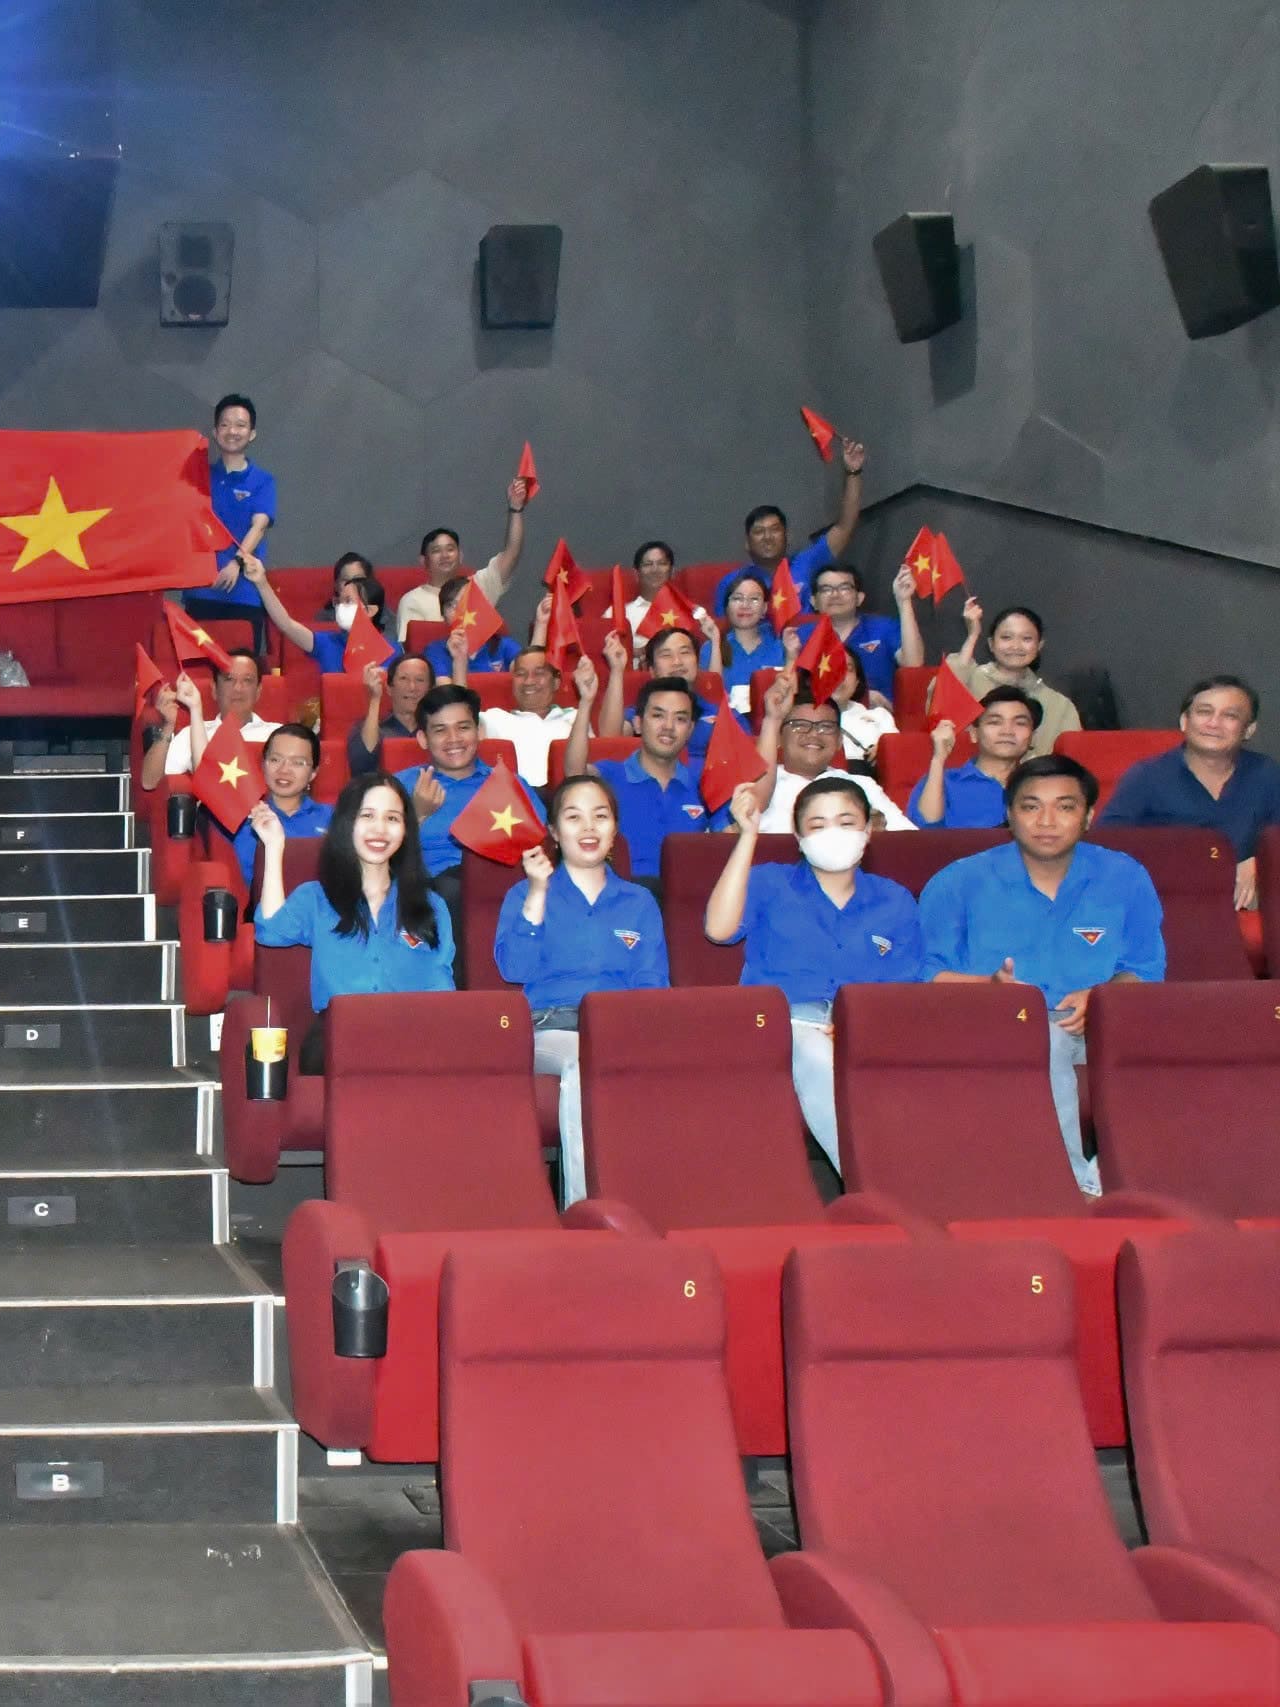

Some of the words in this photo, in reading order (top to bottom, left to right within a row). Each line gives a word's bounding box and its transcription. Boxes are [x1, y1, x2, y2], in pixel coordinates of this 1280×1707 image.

[16, 830, 25, 840] F
[1210, 847, 1219, 858] 2
[18, 918, 29, 929] E
[500, 1015, 509, 1029] 6
[756, 1014, 765, 1028] 5
[1016, 1008, 1027, 1022] 4
[26, 1029, 39, 1041] D
[34, 1202, 49, 1217] C
[683, 1280, 696, 1298] 6
[1031, 1275, 1044, 1294] 5
[52, 1474, 71, 1492] B
